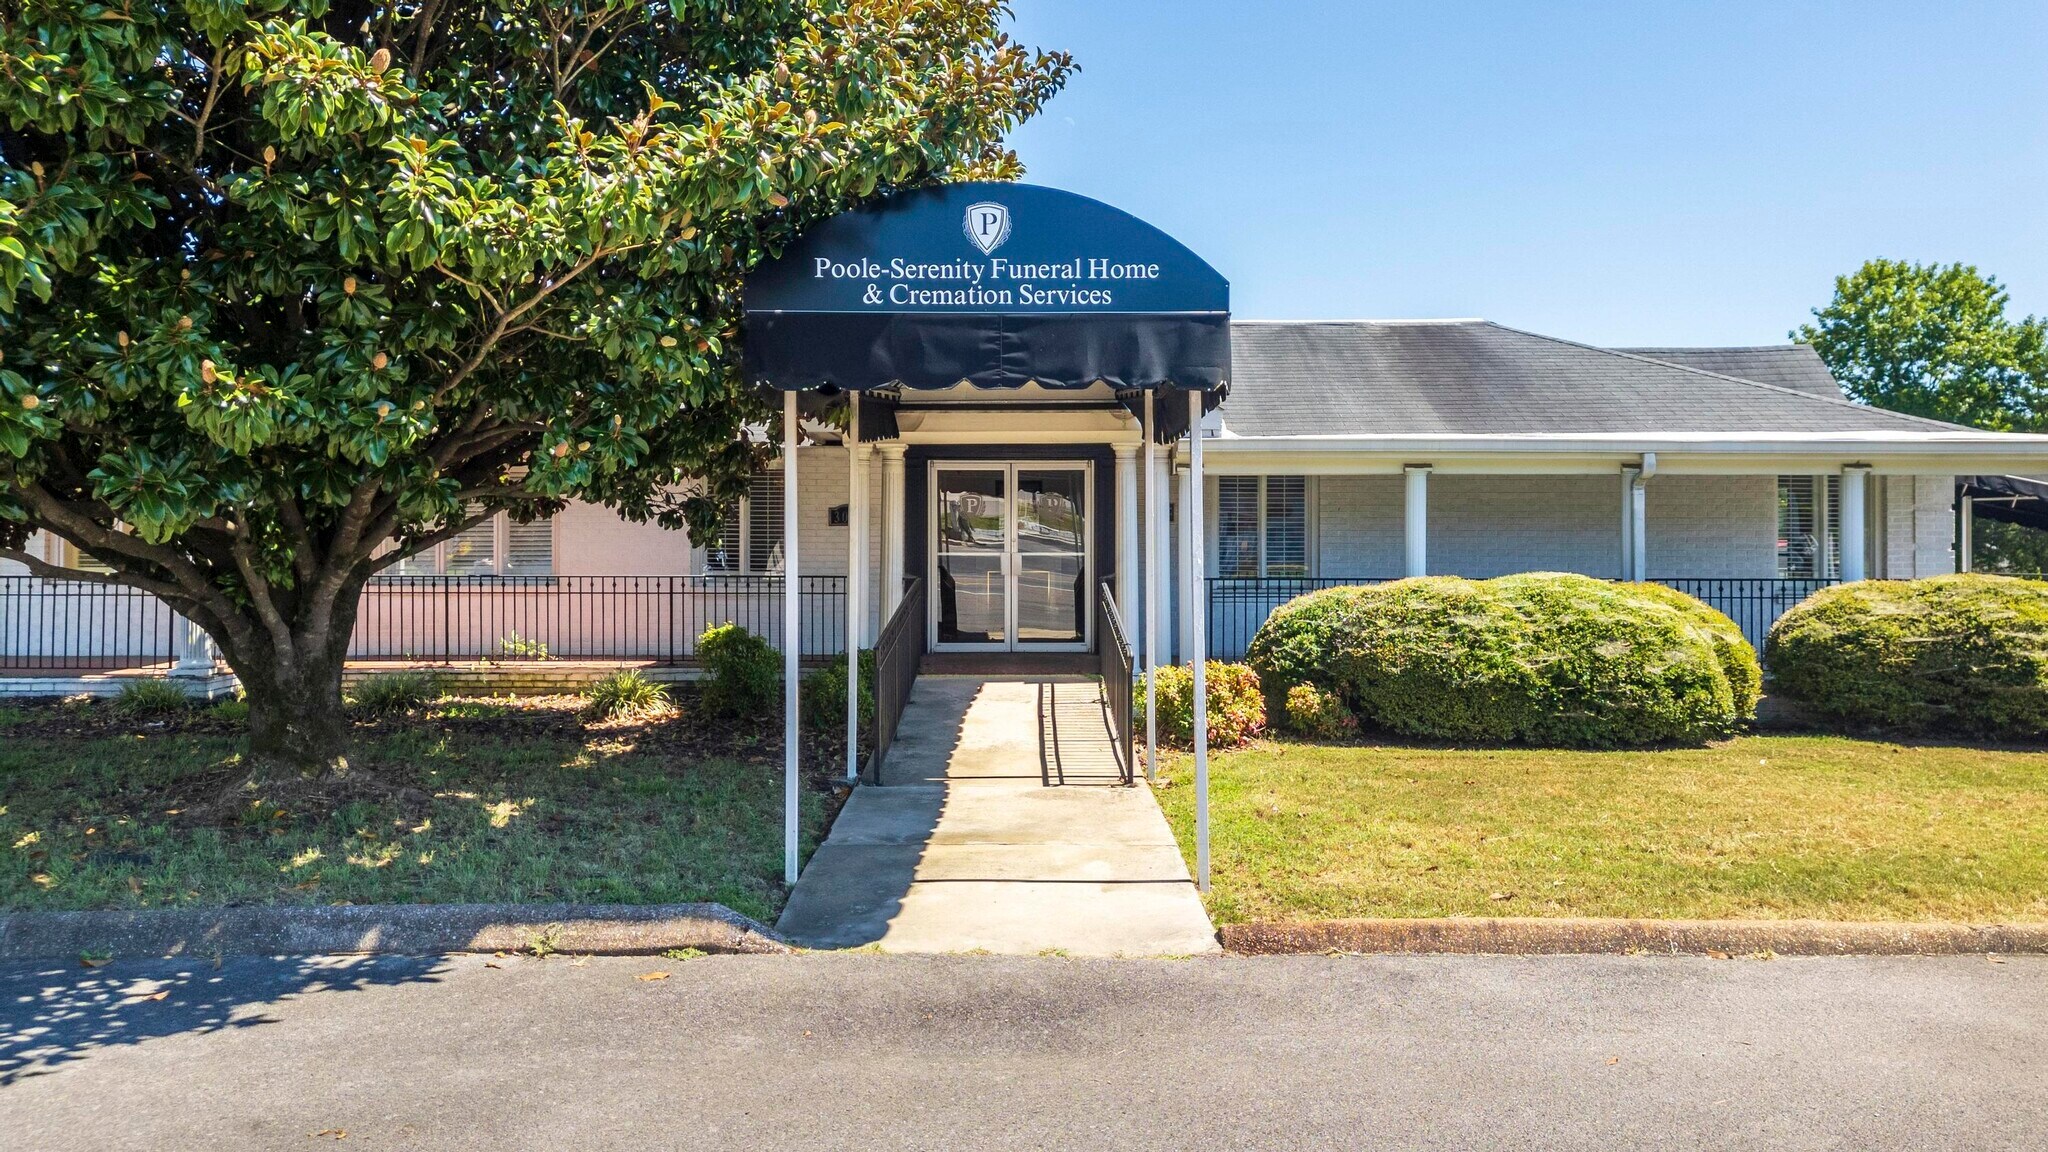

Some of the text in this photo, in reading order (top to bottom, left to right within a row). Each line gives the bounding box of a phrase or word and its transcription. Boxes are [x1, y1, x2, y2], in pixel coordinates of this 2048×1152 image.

[981, 212, 997, 235] P
[814, 257, 1159, 284] Poole-Serenity Funeral Home
[862, 283, 1112, 305] & Cremation Services
[966, 498, 978, 513] P
